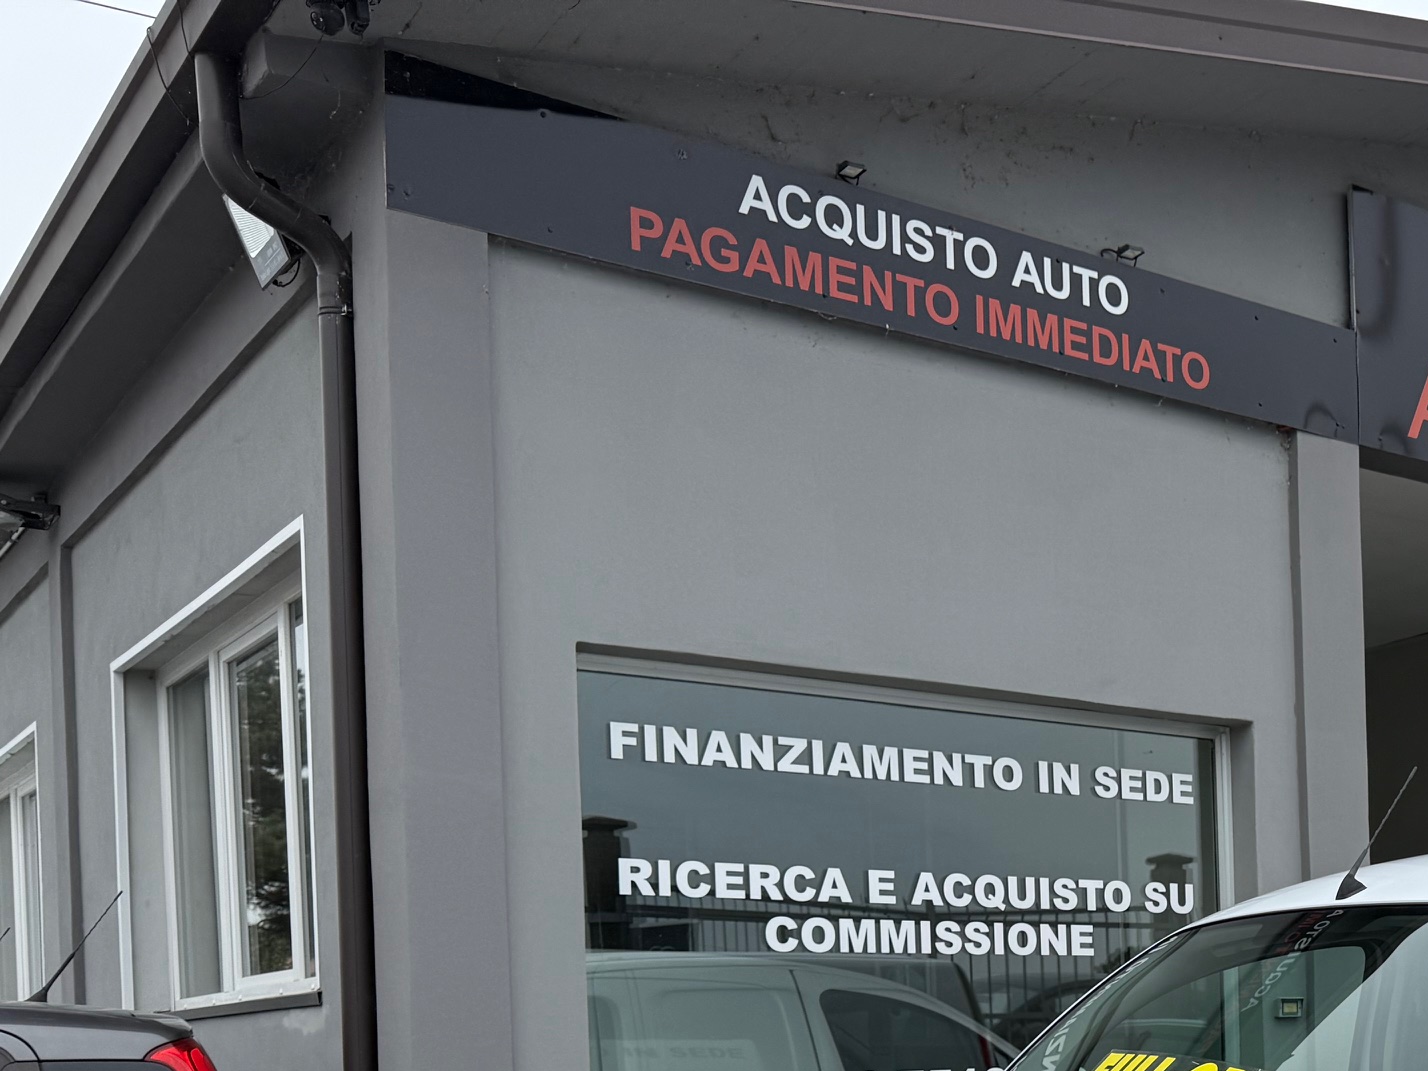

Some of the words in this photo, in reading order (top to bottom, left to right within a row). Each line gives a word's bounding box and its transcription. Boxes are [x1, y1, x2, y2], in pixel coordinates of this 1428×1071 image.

[738, 174, 998, 279] ACQUISTO
[1011, 250, 1129, 315] AUTO
[628, 205, 960, 326] PAGAMENTO
[975, 294, 1210, 390] IMMEDIATO
[608, 721, 1024, 792] FINANZIAMENTO
[1038, 761, 1081, 796] IN
[1093, 766, 1195, 805] SEDE
[617, 856, 852, 904] RICERCA
[868, 869, 897, 905] E
[911, 871, 1133, 914] ACQUISTO
[1143, 882, 1195, 915] SU
[765, 916, 1096, 958] COMMISSIONE
